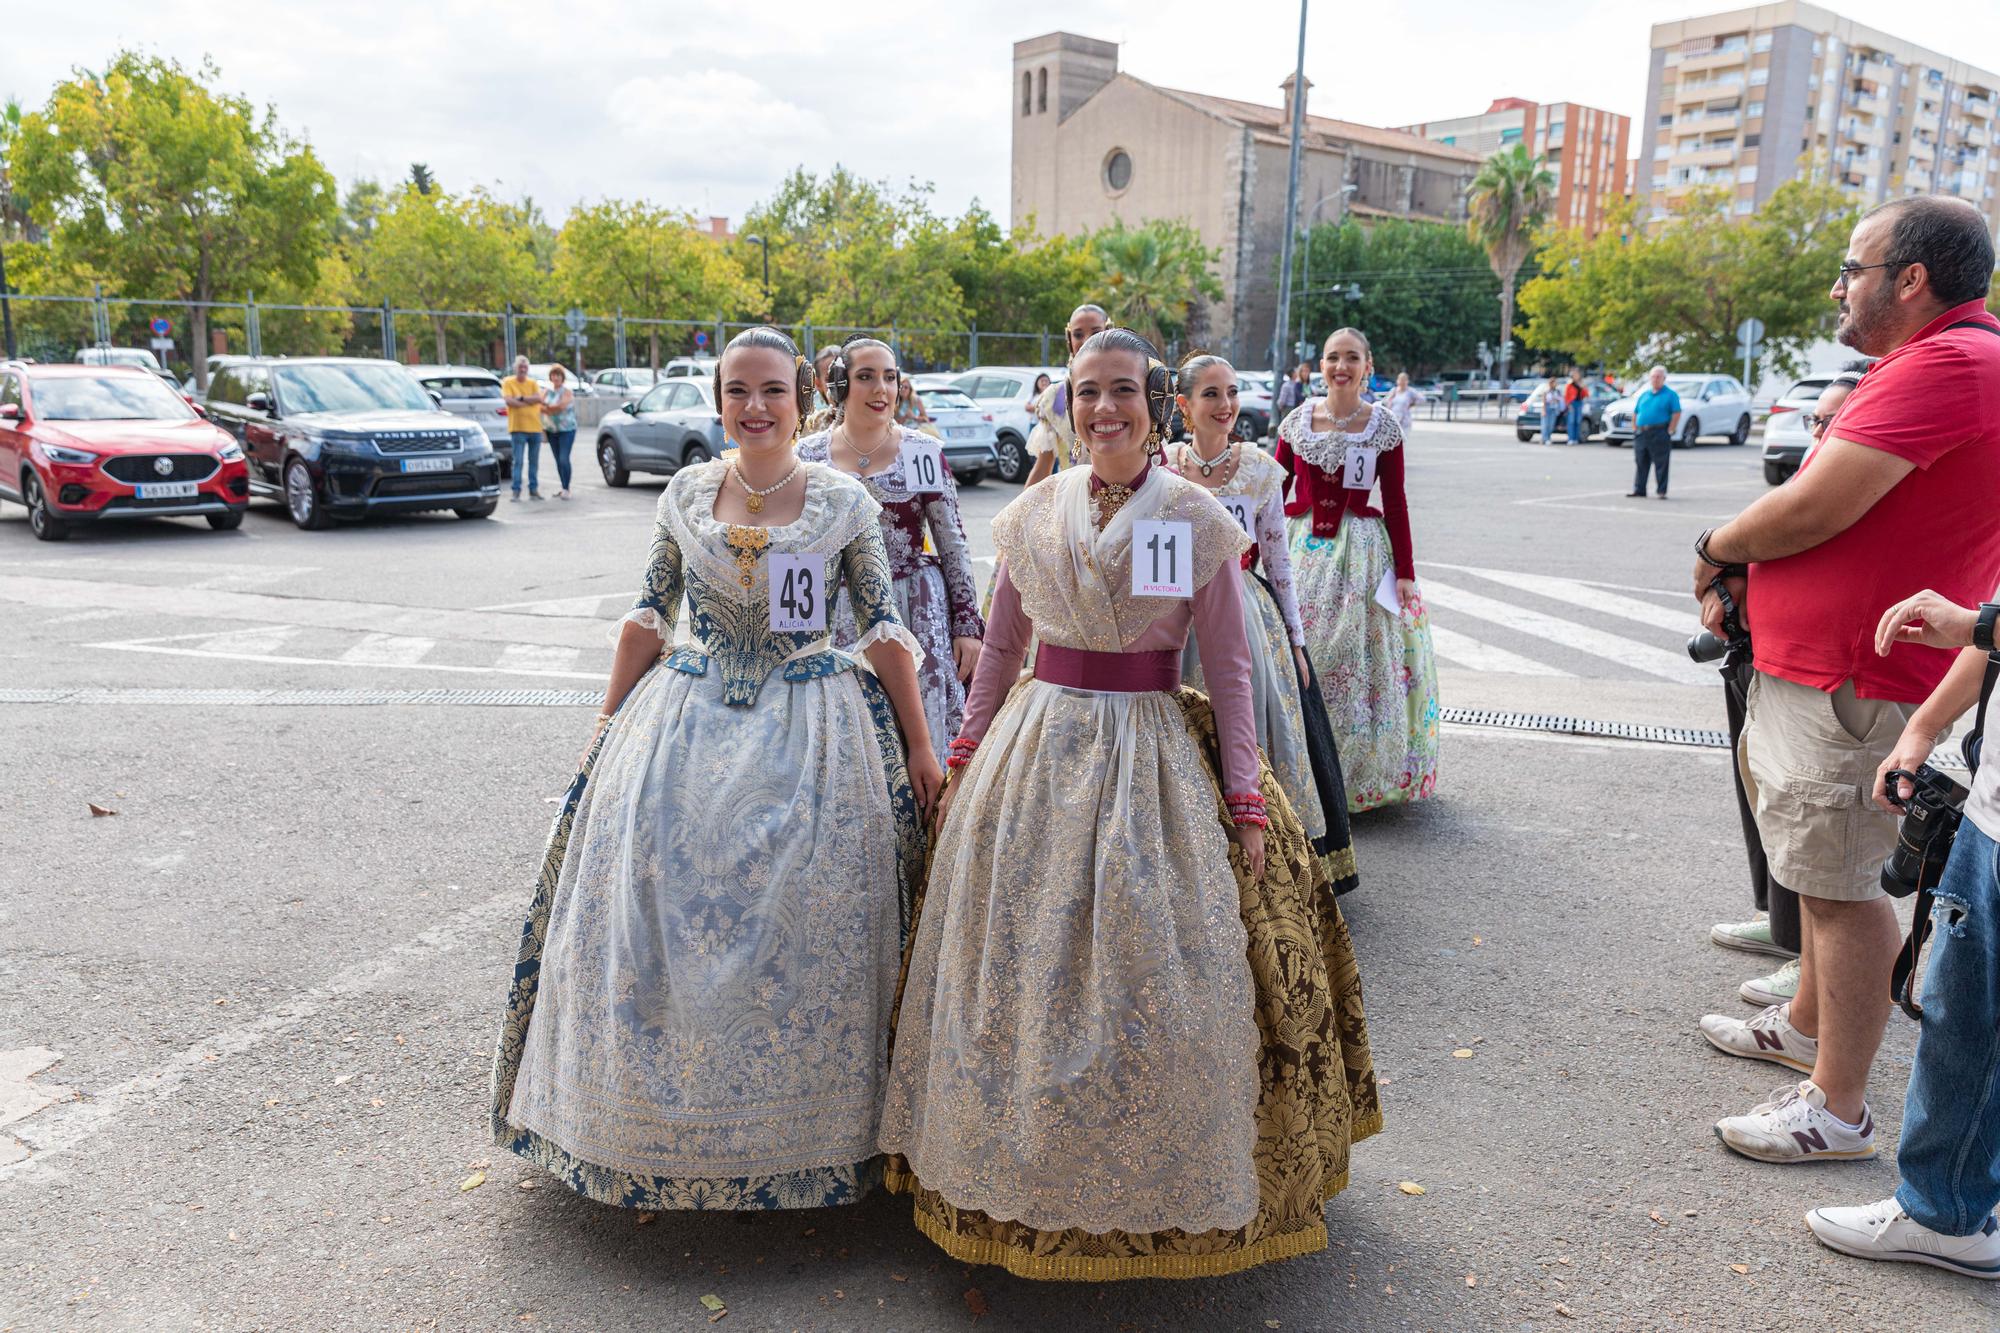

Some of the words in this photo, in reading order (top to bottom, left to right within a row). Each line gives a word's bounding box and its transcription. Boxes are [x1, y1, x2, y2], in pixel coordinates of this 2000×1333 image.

[420, 430, 458, 438] ROVER
[912, 454, 935, 485] 10
[1355, 455, 1365, 482] 3
[1225, 504, 1247, 533] 3
[1147, 534, 1176, 584] 11
[780, 567, 814, 620] 43
[1150, 585, 1182, 593] VICTORIA
[779, 620, 805, 628] ALICIA
[1752, 1029, 1785, 1051] N
[1791, 1127, 1829, 1154] N
